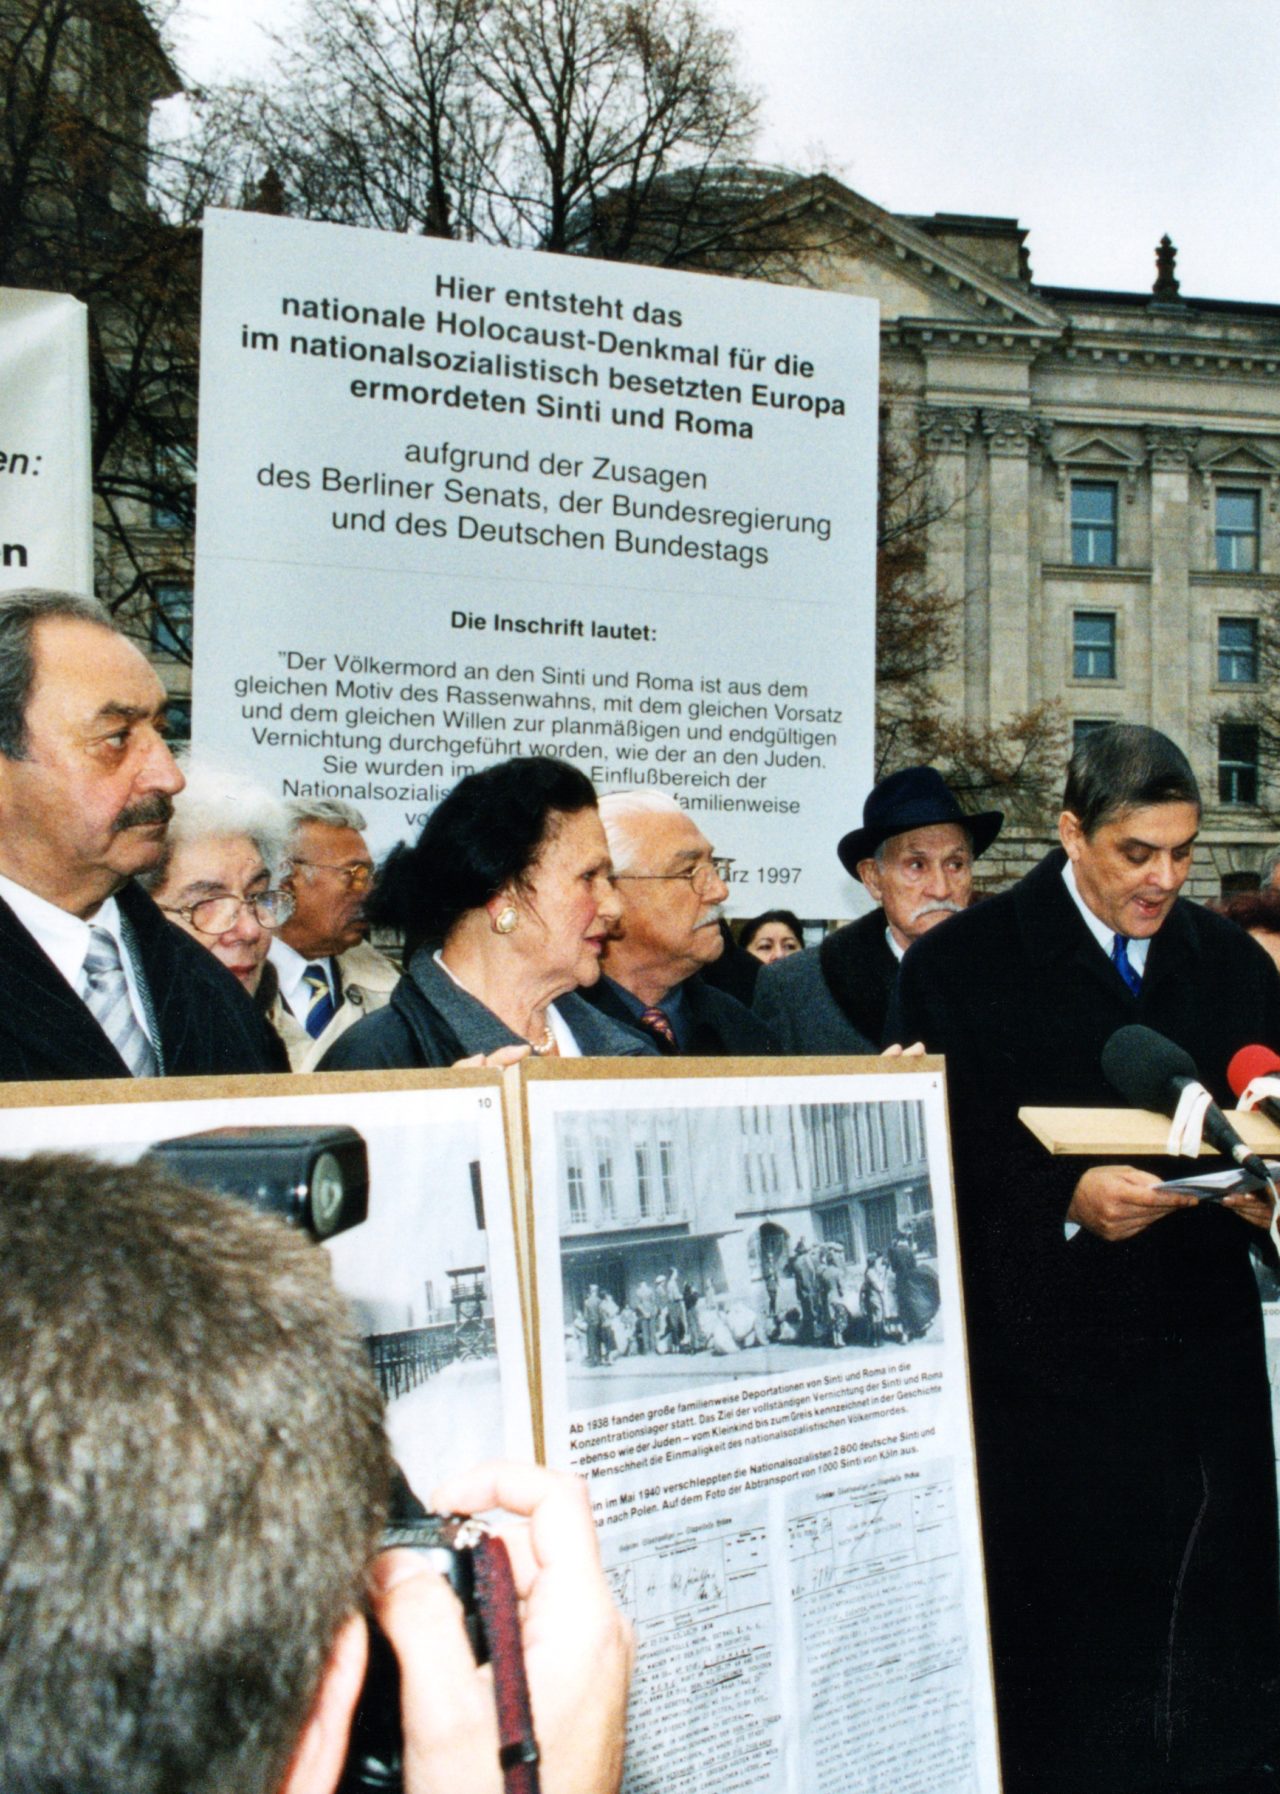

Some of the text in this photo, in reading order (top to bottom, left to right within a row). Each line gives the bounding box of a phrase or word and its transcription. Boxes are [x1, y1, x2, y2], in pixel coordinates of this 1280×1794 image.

[435, 274, 682, 327] Hier entsteht das
[282, 297, 814, 378] nationale Holocaust-Denkmal für die
[241, 324, 845, 419] im nationalsozialistisch besetzten Europa
[350, 379, 753, 439] ermordeten Sinti und Roma
[404, 441, 706, 492] aufgrund der Zusagen
[256, 462, 831, 541] des Berliner Senats, der Bundesregierung
[332, 509, 768, 569] und des Deutschen Bundestags
[451, 610, 656, 641] Die Inschrift lautet:
[234, 675, 842, 723] gleichen Motiv des Rassenwahns, mit dem gleichen Vorsatz
[333, 653, 456, 678] Völkermord
[463, 665, 488, 680] an
[496, 664, 534, 682] den
[541, 665, 585, 685] Sinti
[592, 671, 628, 688] und
[636, 671, 693, 692] Roma
[700, 678, 721, 693] ist
[727, 681, 761, 696] aus
[767, 680, 807, 697] dem
[241, 702, 836, 749] und dem gleichen Willen zur planmäßigen und endgültigen
[251, 727, 826, 767] Vernichtung durchgeführt worden, wie der an den Juden.
[323, 755, 766, 789] Sie wurden im Einflußbereich der
[757, 867, 802, 884] 1997
[478, 1097, 492, 1110] 10
[569, 1423, 583, 1434] Ab
[586, 1416, 609, 1430] 1938
[611, 1411, 645, 1425] fanden
[647, 1404, 675, 1421] große
[677, 1394, 739, 1412] familienweise
[741, 1382, 804, 1400] Deportationen
[806, 1379, 821, 1388] von
[823, 1375, 842, 1385] Sinti
[845, 1371, 860, 1381] und
[862, 1367, 886, 1377] Roma
[898, 1363, 910, 1371] die
[569, 1422, 668, 1450] Konzentrationslager
[698, 1413, 715, 1424] Das
[717, 1409, 733, 1420] Ziel
[735, 1407, 750, 1417] der
[752, 1395, 810, 1413] vollständigen
[812, 1385, 864, 1401] Vernichtung
[865, 1383, 879, 1391] der
[881, 1378, 901, 1388] Sinti
[903, 1375, 919, 1384] und
[920, 1371, 942, 1381] Roma
[591, 1457, 648, 1478] Menschheit
[649, 1455, 663, 1465] die
[665, 1441, 725, 1462] Einmaligkeit
[727, 1439, 742, 1449] des
[744, 1418, 845, 1444] nationalsozialistischen
[847, 1406, 908, 1423] Völkermordes.
